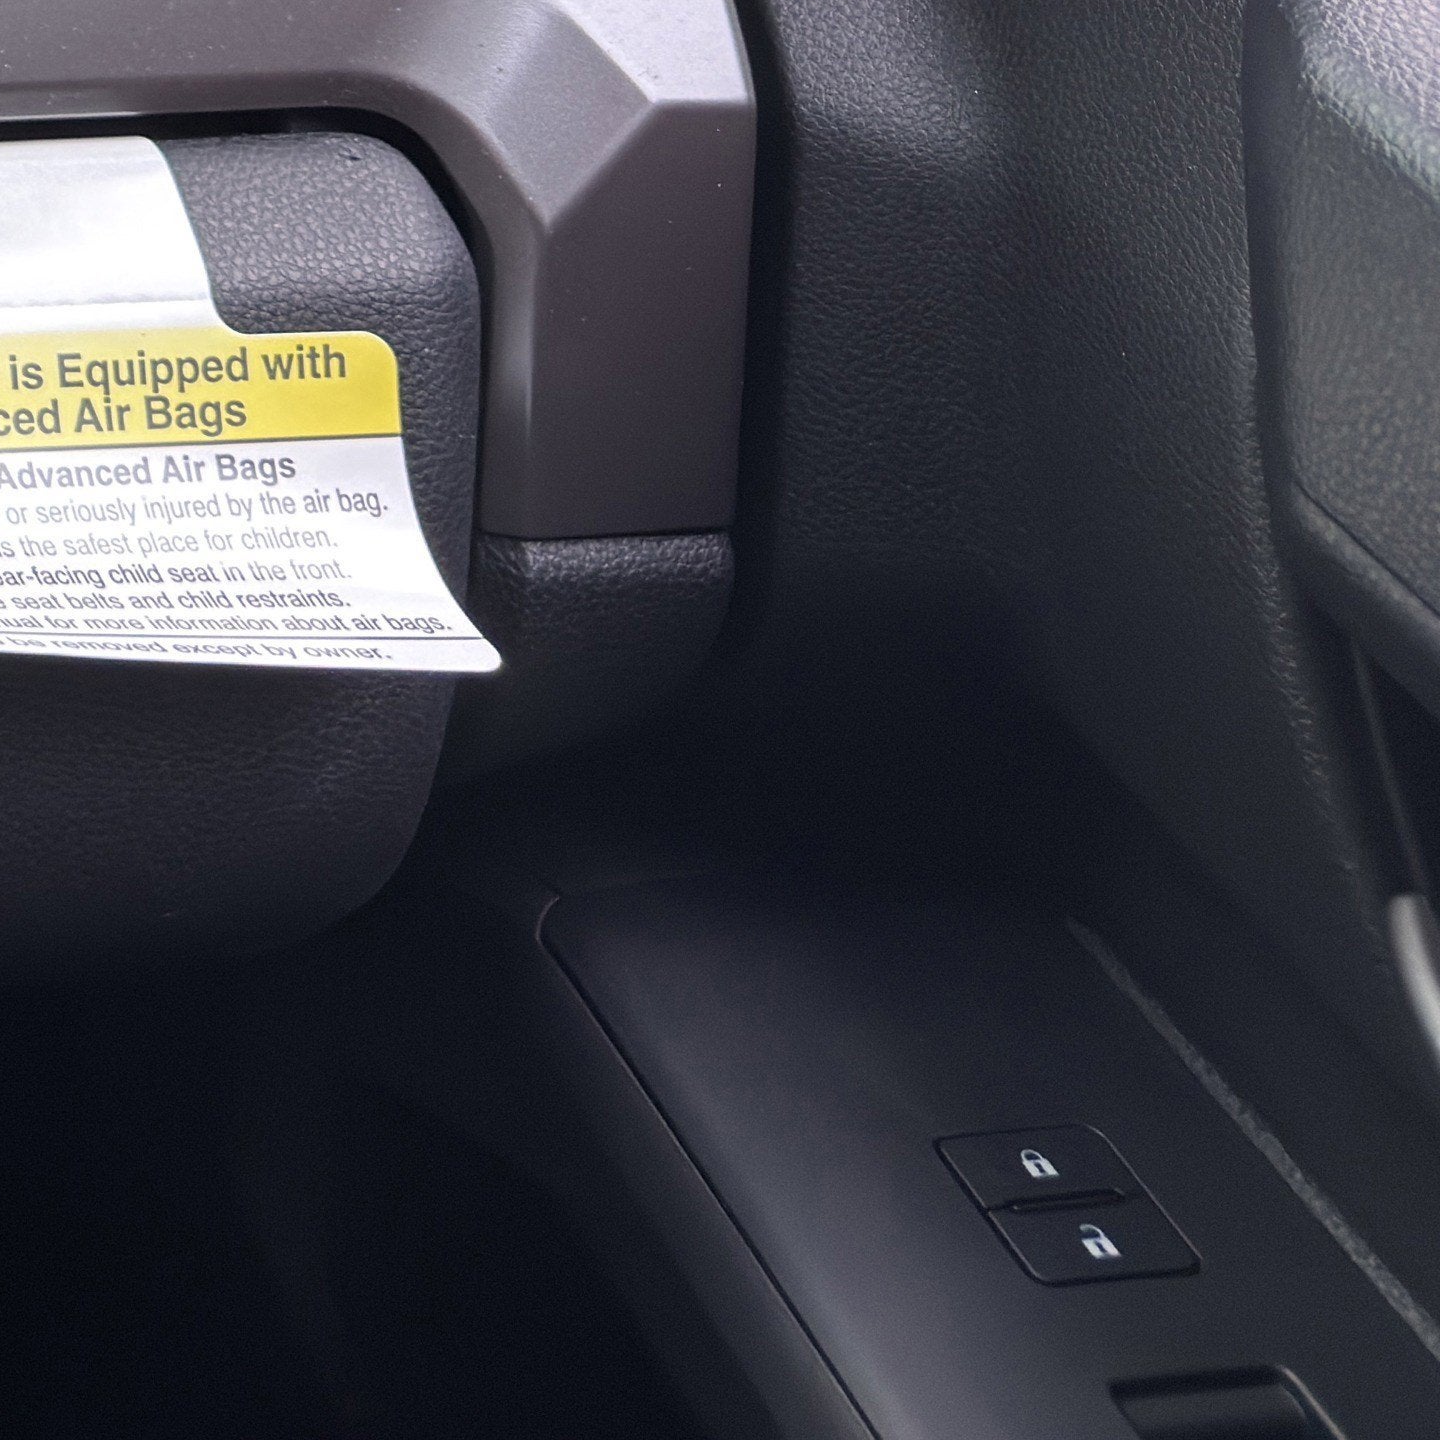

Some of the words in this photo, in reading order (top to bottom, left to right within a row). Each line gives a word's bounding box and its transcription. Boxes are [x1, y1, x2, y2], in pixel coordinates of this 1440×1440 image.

[9, 354, 43, 390] is
[57, 346, 249, 395] Equipped
[261, 344, 347, 380] with
[74, 396, 130, 433] Air
[144, 395, 247, 437] Bags
[162, 455, 205, 483] Air
[215, 453, 296, 486] Bags
[6, 506, 27, 524] or
[36, 497, 136, 526] seriously
[141, 492, 221, 525] injured
[225, 492, 252, 521] by
[259, 491, 296, 516] the
[303, 488, 331, 513] air
[336, 488, 388, 517] bag.
[19, 534, 57, 557] the
[63, 532, 133, 556] safest
[137, 531, 199, 558] place
[204, 529, 233, 552] for
[241, 526, 338, 551] children.
[109, 564, 164, 584] child
[167, 564, 220, 583] seat
[220, 561, 246, 582] in
[248, 560, 287, 581] the
[290, 559, 352, 581] front.
[11, 594, 65, 610] seat
[63, 592, 124, 610] belts
[128, 591, 174, 609] and
[178, 590, 233, 608] child
[236, 589, 351, 608] restraints.
[44, 615, 77, 629] for
[83, 619, 145, 630] more
[145, 615, 278, 631] information
[284, 615, 351, 631] about
[351, 614, 381, 631] air
[381, 614, 452, 634] bags.
[6, 636, 46, 647] be
[50, 640, 168, 653] removed
[173, 643, 258, 658] except
[261, 643, 297, 659] by
[303, 645, 393, 659] owner.
